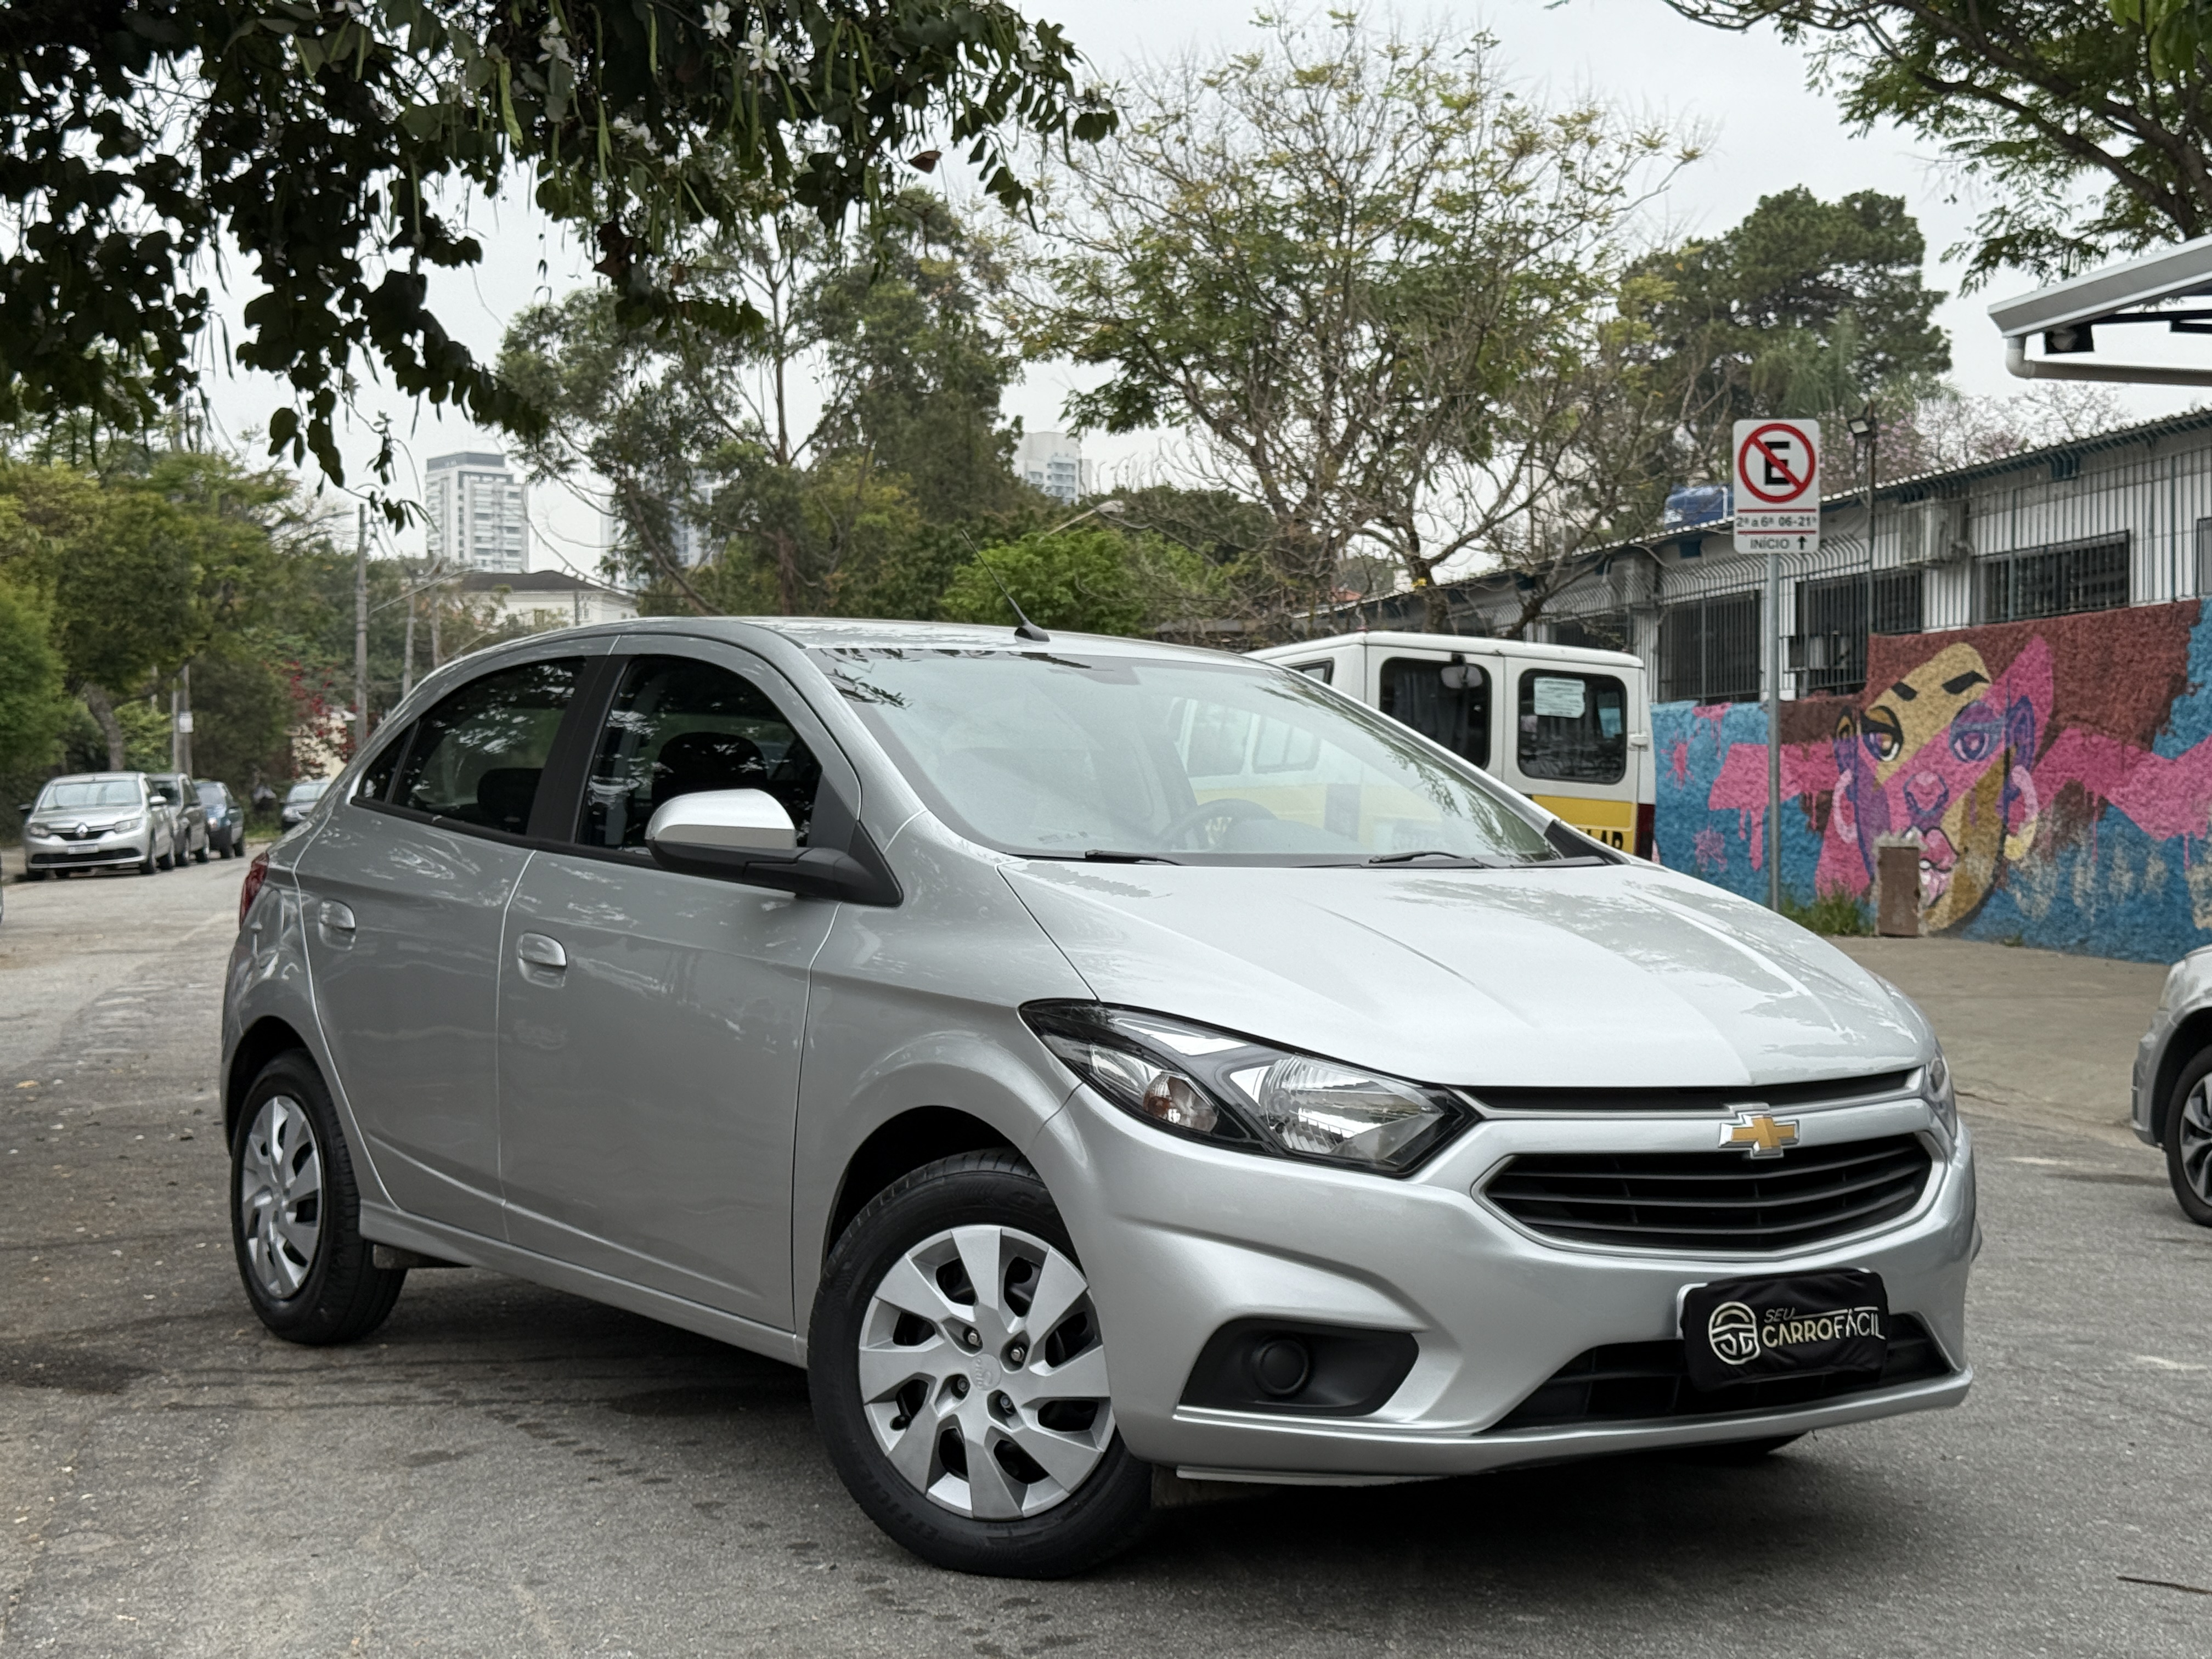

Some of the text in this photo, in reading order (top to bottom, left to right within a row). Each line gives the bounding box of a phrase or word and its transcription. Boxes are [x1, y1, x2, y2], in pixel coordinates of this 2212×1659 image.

[1764, 441, 1790, 485] E
[1751, 518, 1758, 527] a
[1763, 1307, 1796, 1324] SEU
